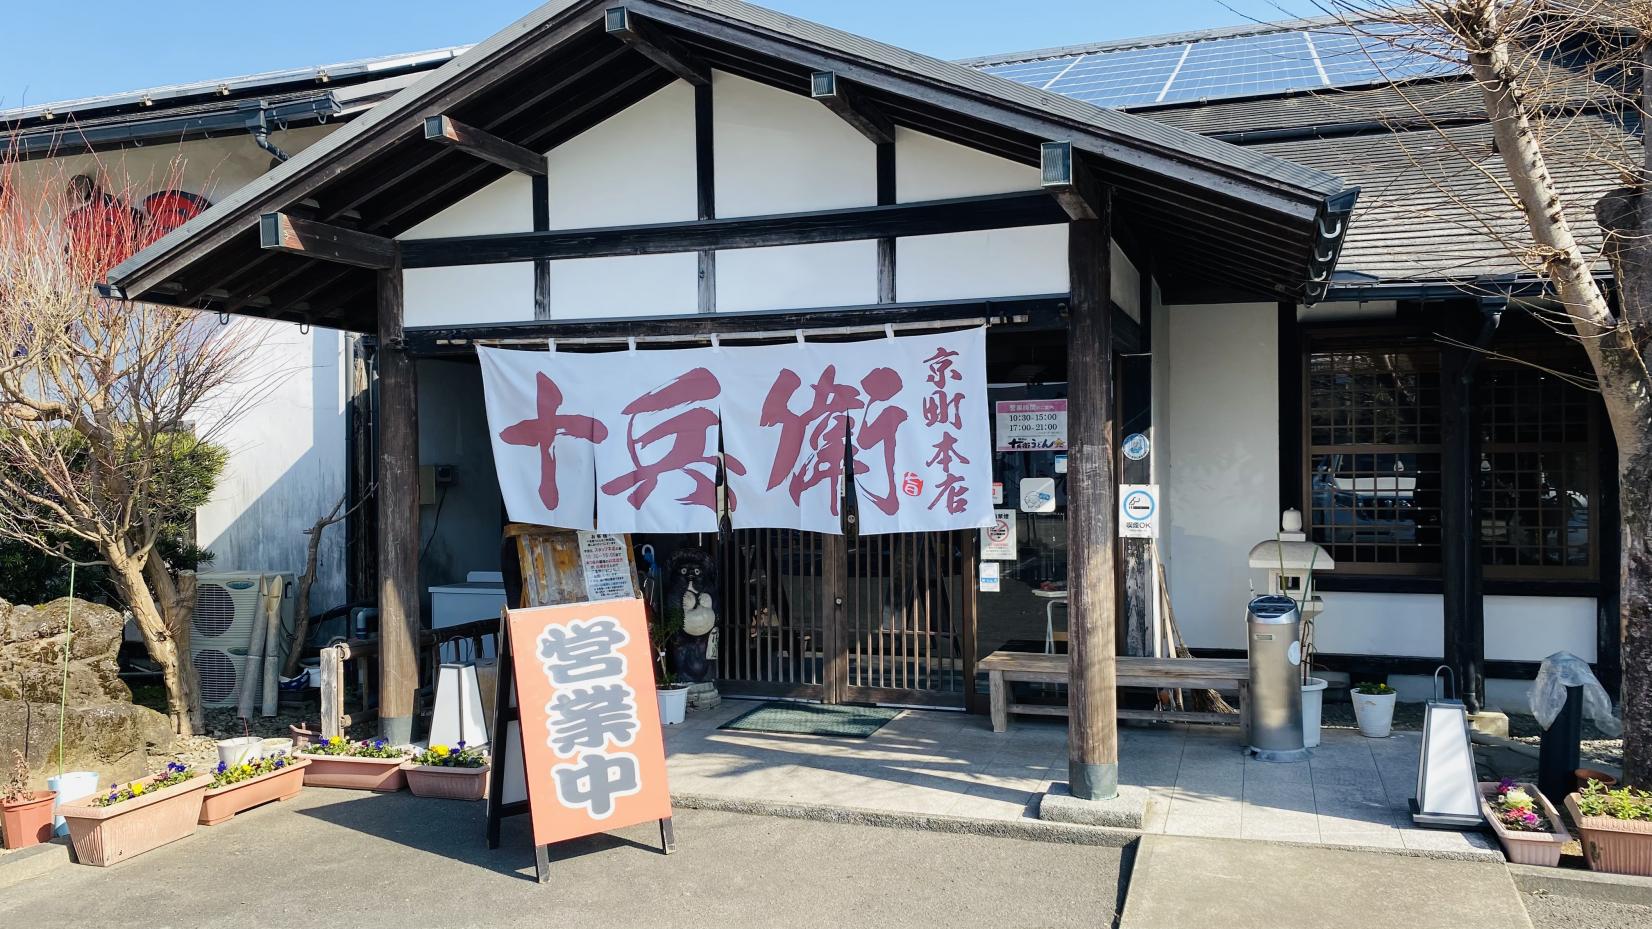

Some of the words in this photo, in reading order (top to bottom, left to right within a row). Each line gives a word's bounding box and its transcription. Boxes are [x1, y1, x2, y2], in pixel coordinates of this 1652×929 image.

[499, 364, 908, 517] 十兵衛
[922, 346, 970, 516] 京町本店
[537, 615, 642, 820] 営業中
